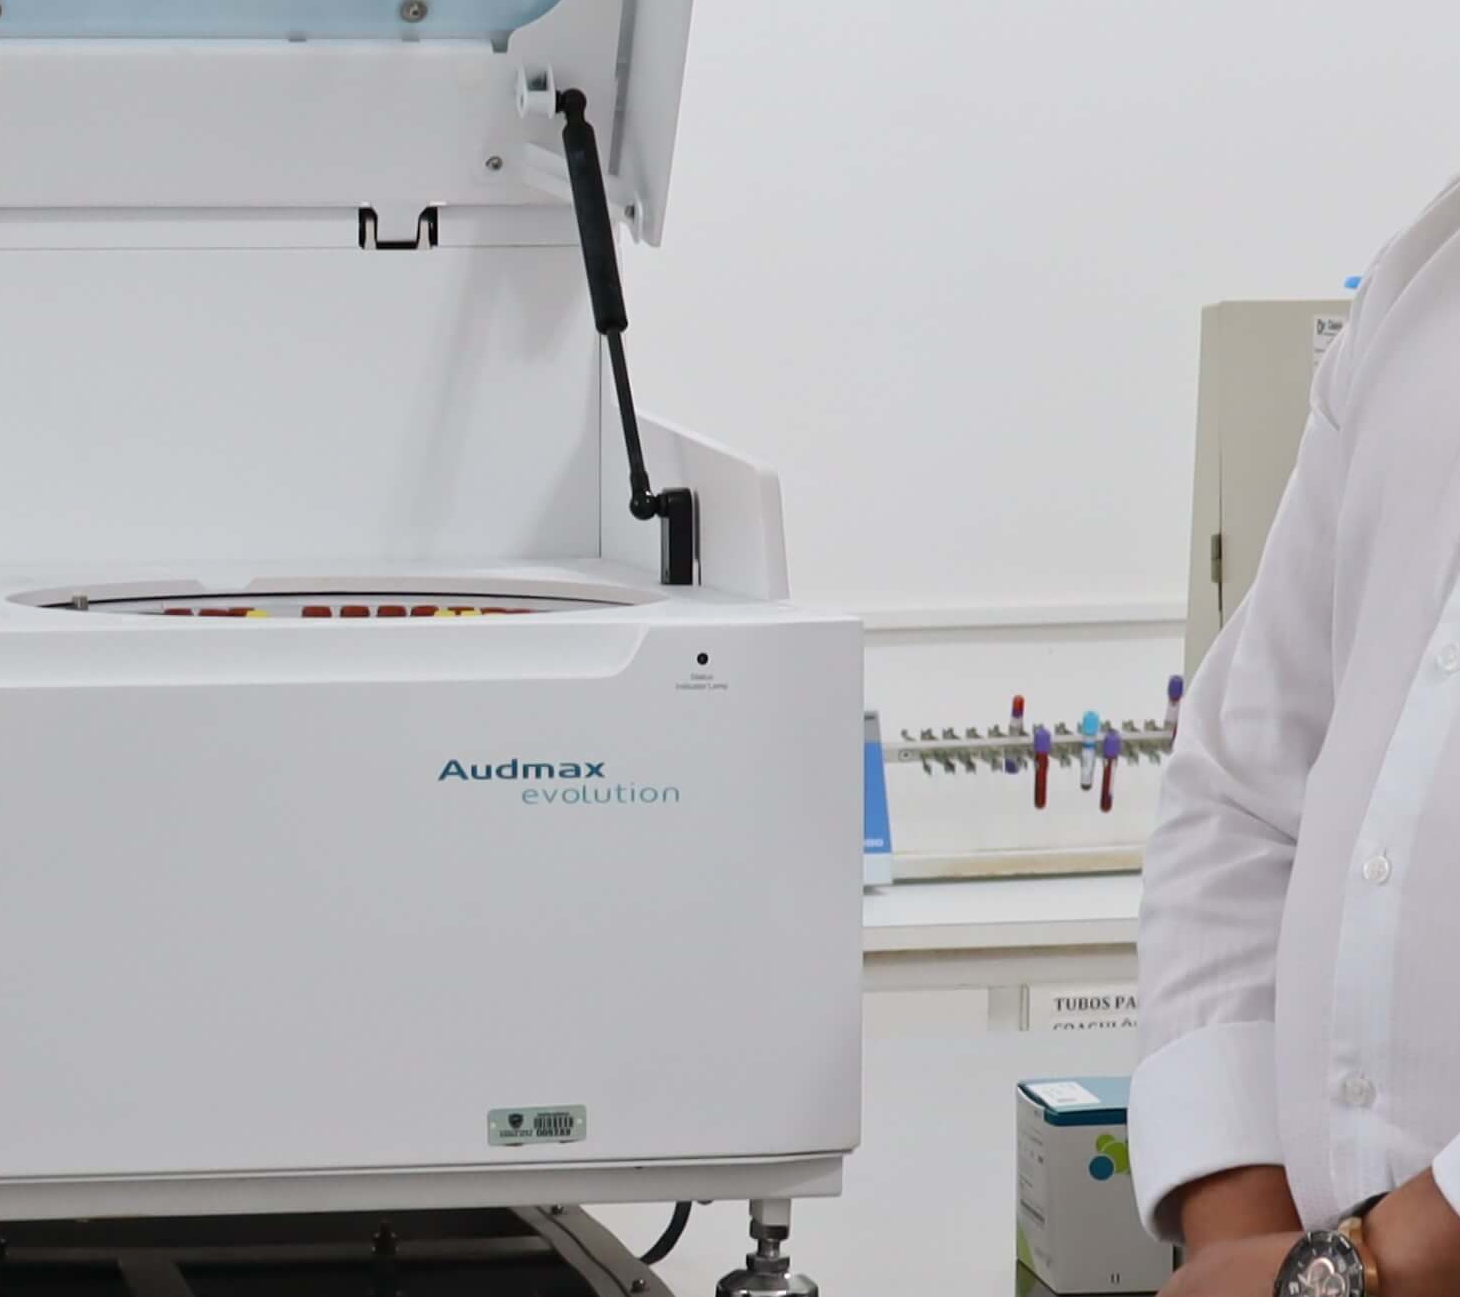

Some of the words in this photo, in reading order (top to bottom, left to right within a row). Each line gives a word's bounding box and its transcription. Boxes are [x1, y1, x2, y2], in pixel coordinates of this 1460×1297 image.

[438, 758, 606, 781] Audmax
[520, 782, 680, 805] evolution
[1052, 996, 1111, 1012] TUBOS
